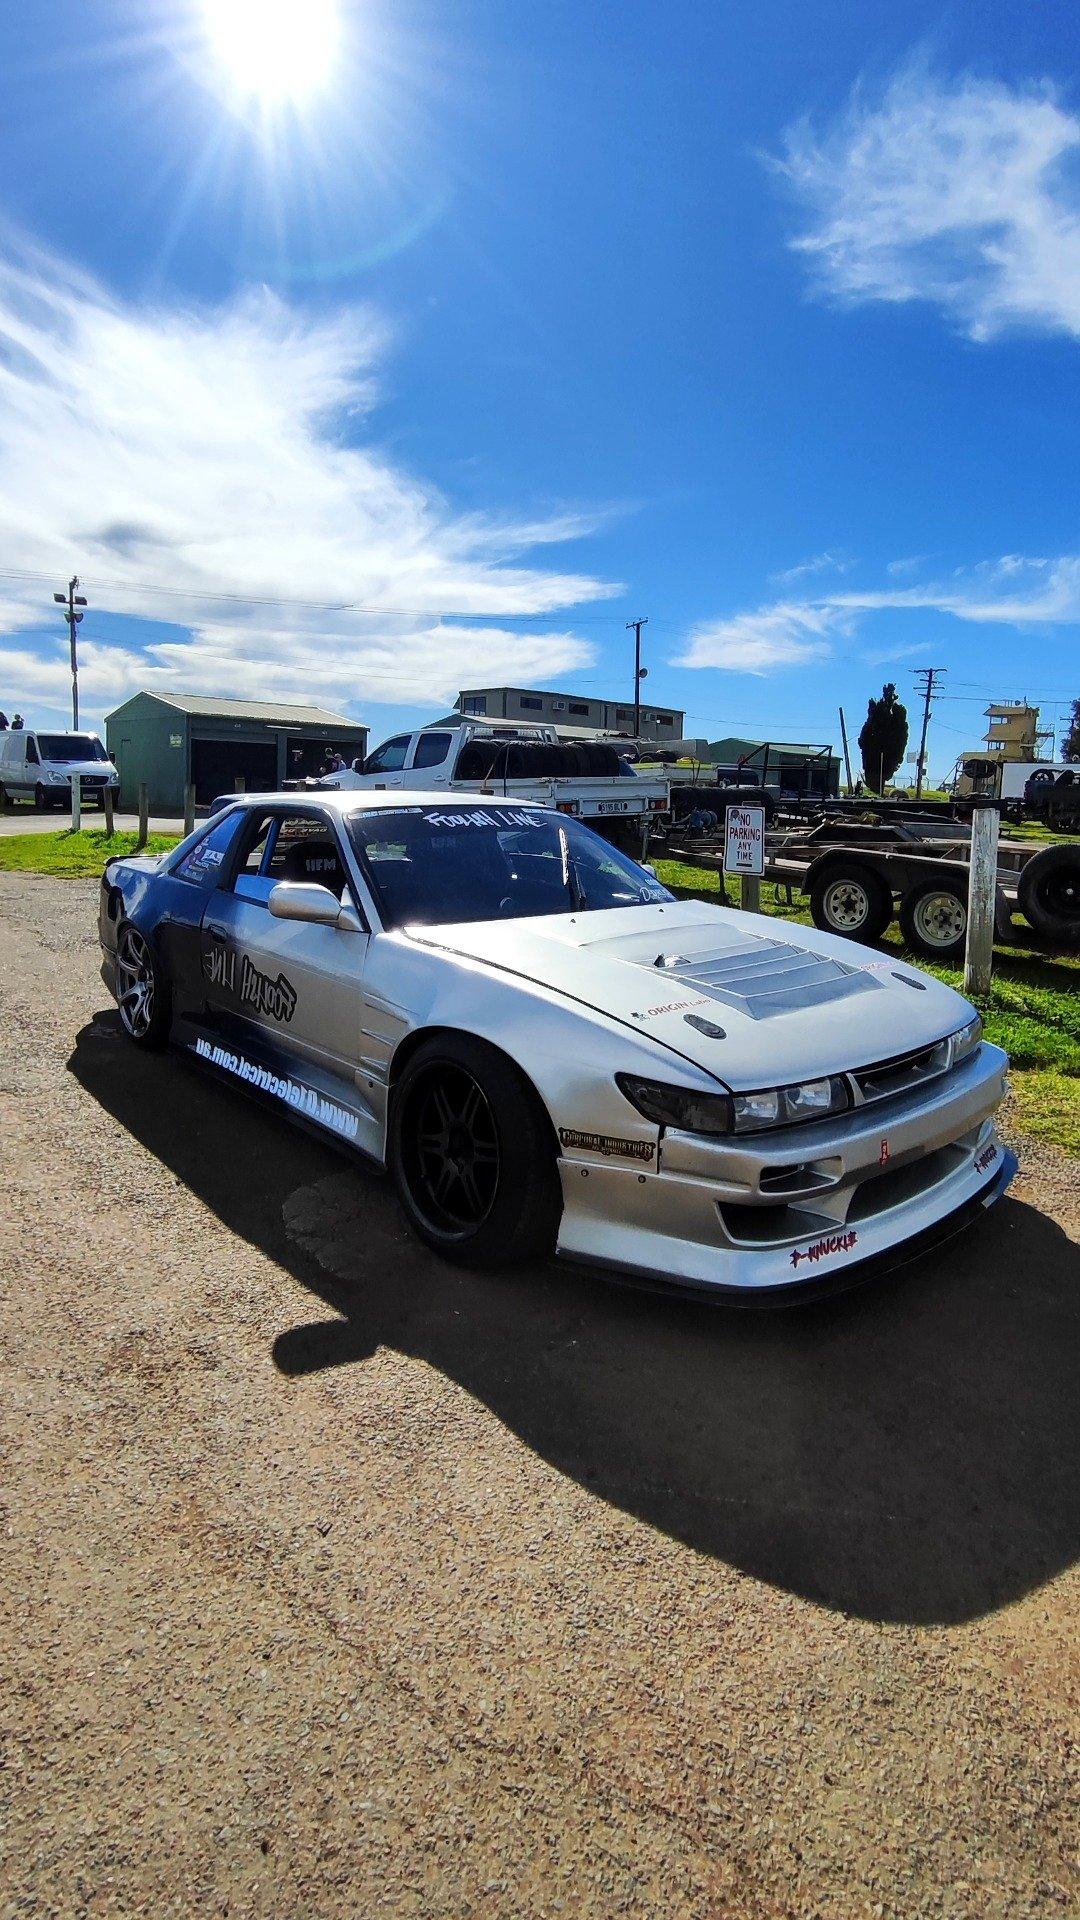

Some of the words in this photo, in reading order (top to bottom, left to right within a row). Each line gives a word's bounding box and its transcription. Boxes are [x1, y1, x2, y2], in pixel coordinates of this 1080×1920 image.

[495, 810, 547, 827] LINE
[740, 813, 751, 827] NO
[729, 826, 761, 842] PARKING
[737, 841, 752, 851] ANY
[736, 850, 753, 861] TIME
[647, 1001, 689, 1016] ORIGIN
